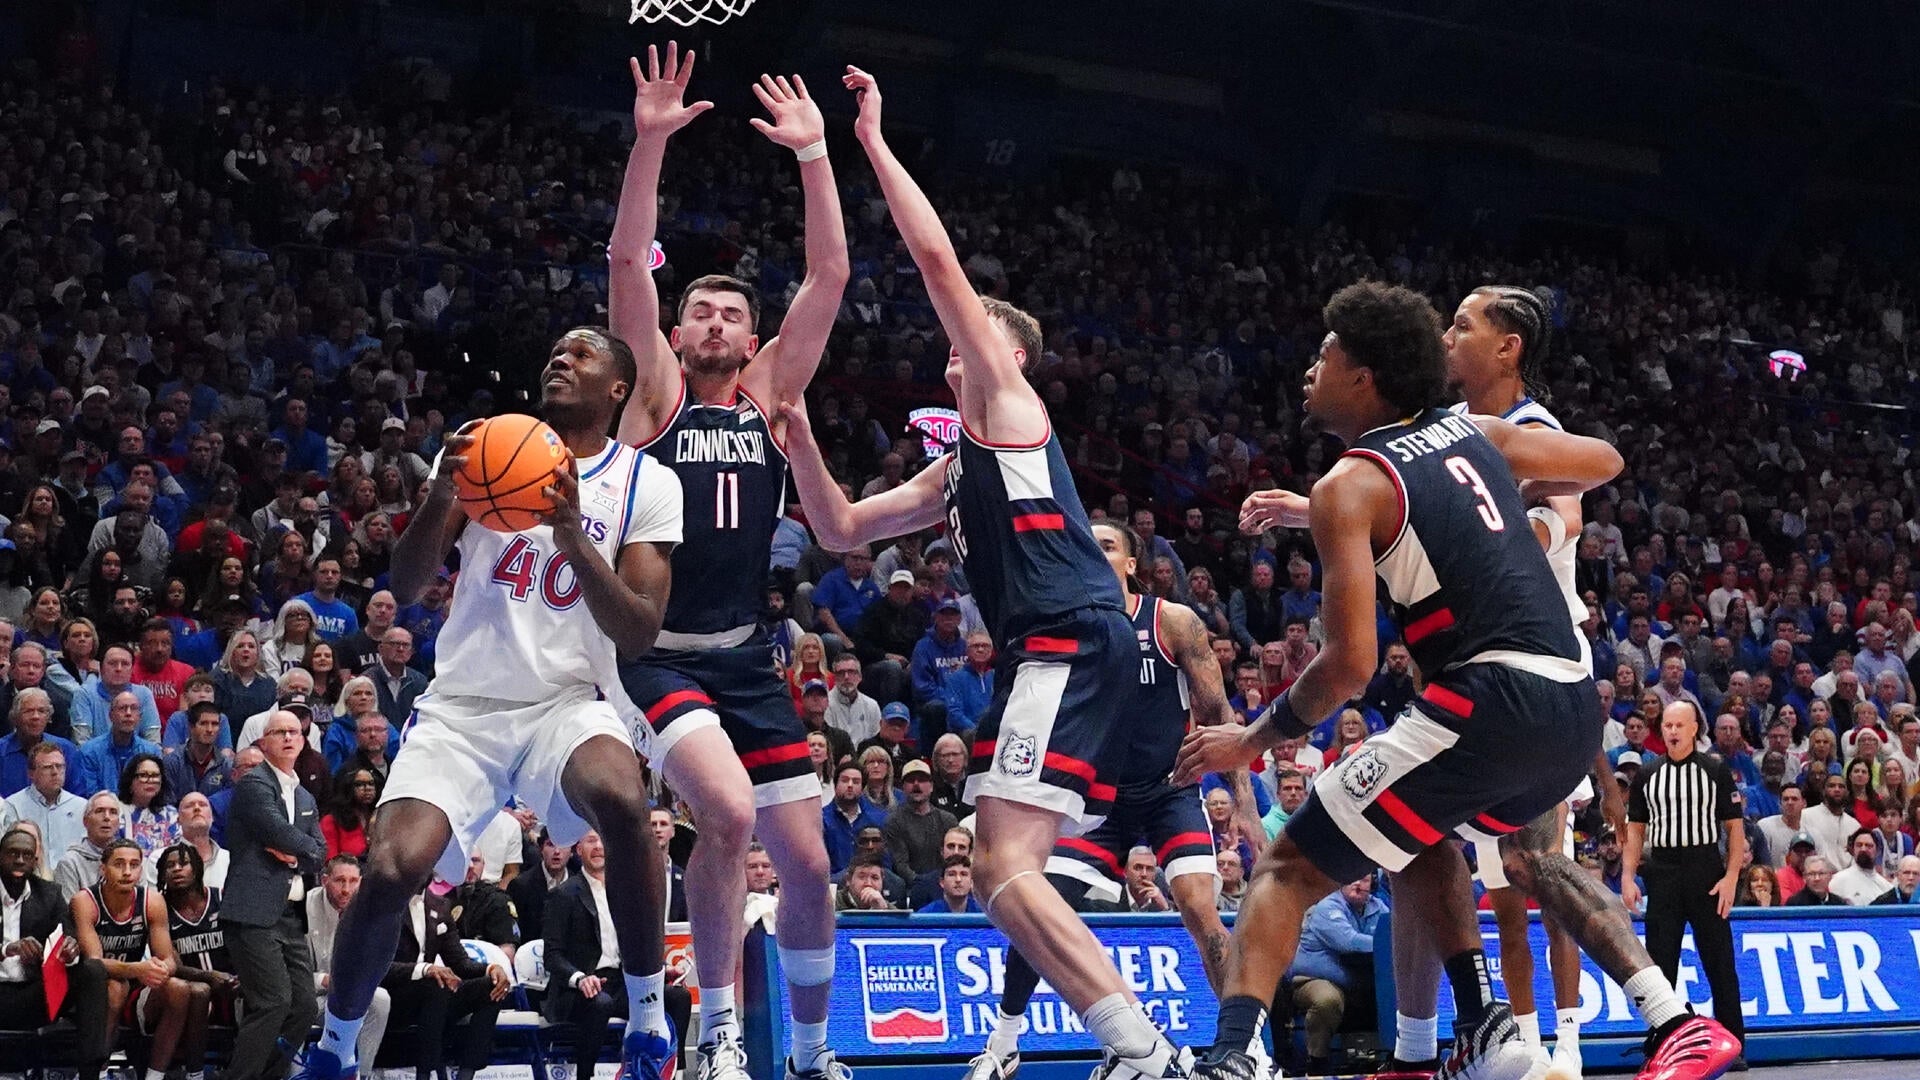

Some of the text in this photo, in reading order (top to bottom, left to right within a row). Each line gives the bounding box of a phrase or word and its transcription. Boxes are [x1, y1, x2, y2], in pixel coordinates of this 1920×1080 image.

[1385, 415, 1476, 463] STEWART
[714, 471, 739, 530] 11
[1444, 455, 1505, 532] 3
[491, 533, 584, 611] 40
[177, 931, 224, 954] ONNECTICU
[868, 966, 937, 981] SHELTER
[869, 982, 937, 993] INSURANCE
